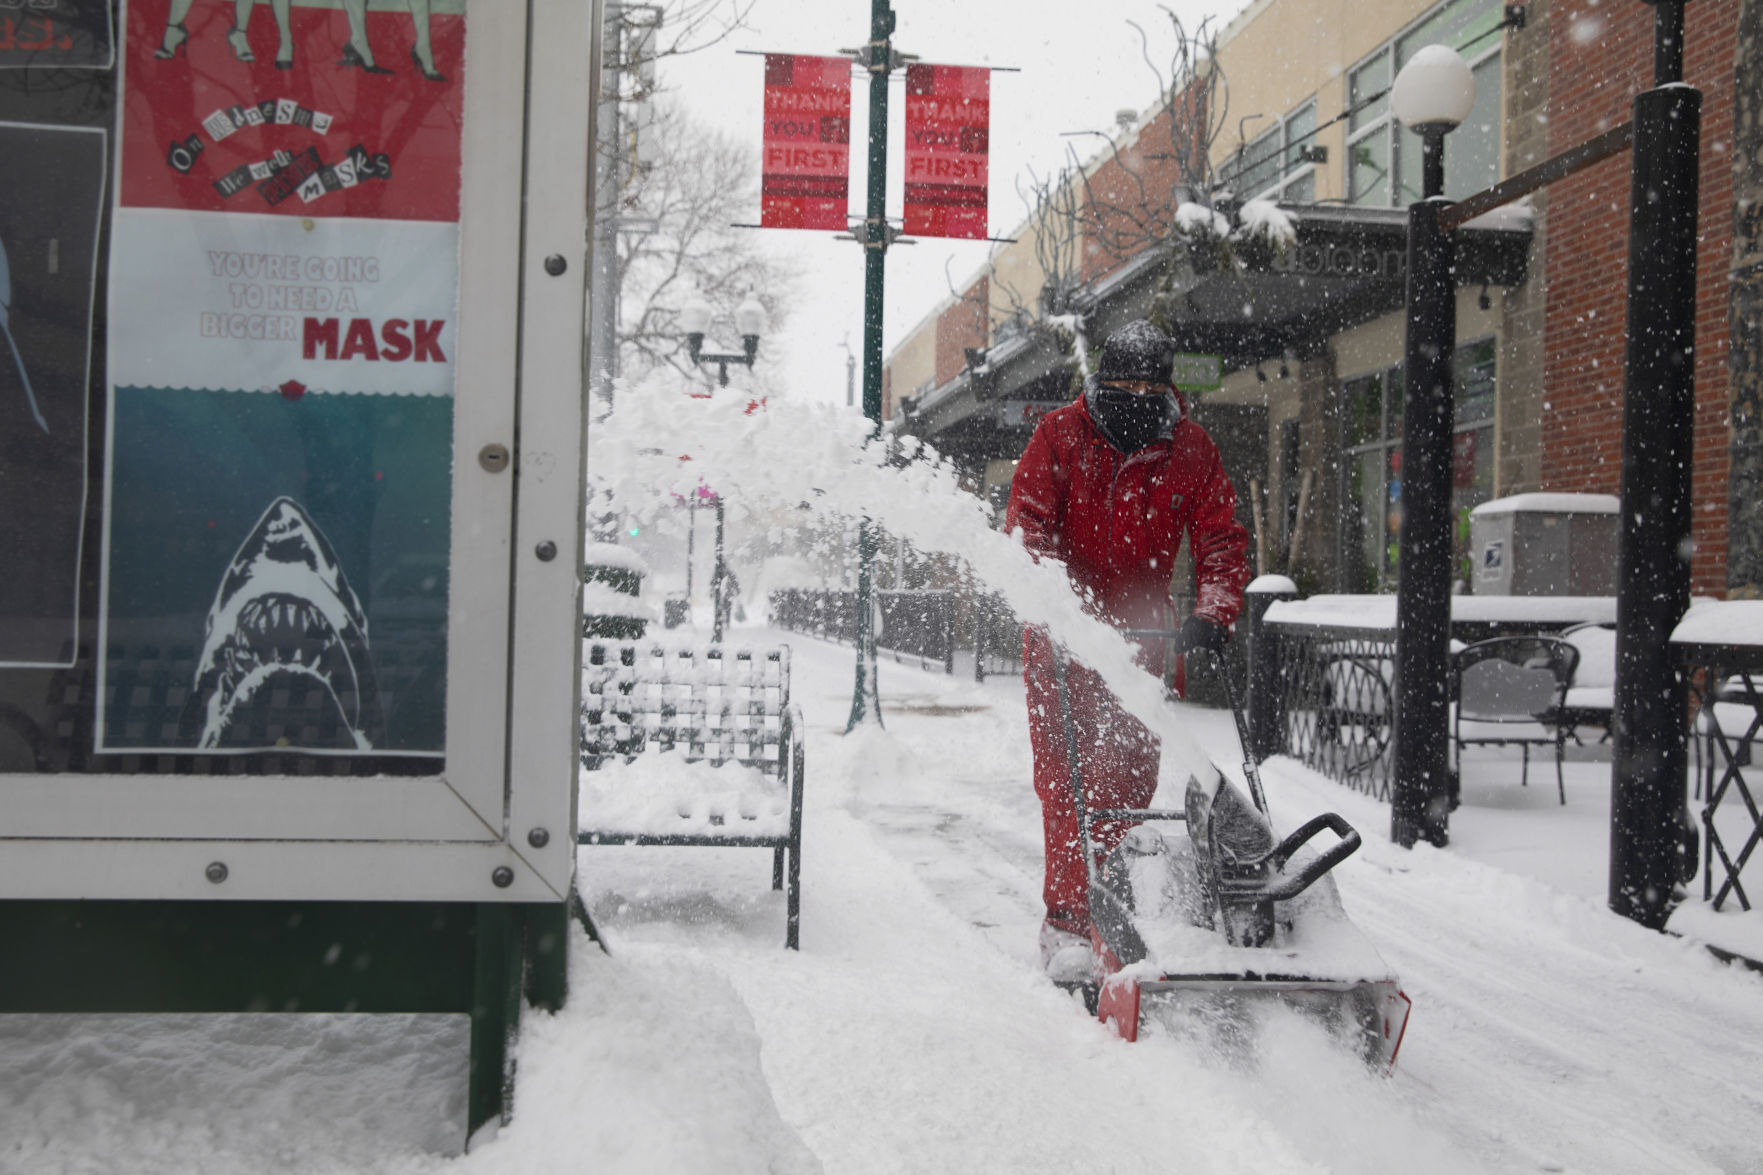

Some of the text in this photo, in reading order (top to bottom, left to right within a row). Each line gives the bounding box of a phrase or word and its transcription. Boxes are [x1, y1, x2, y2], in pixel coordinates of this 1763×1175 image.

[768, 93, 847, 111] THANK
[908, 102, 985, 121] THANK
[770, 120, 813, 136] YOU
[912, 129, 955, 145] YOU
[169, 136, 204, 172] On
[768, 148, 844, 168] FIRST
[910, 157, 984, 179] FIRST
[208, 250, 380, 283] YOU'RE GOING
[229, 282, 360, 312] TO NEED A
[200, 311, 449, 363] BIGGER MASK
